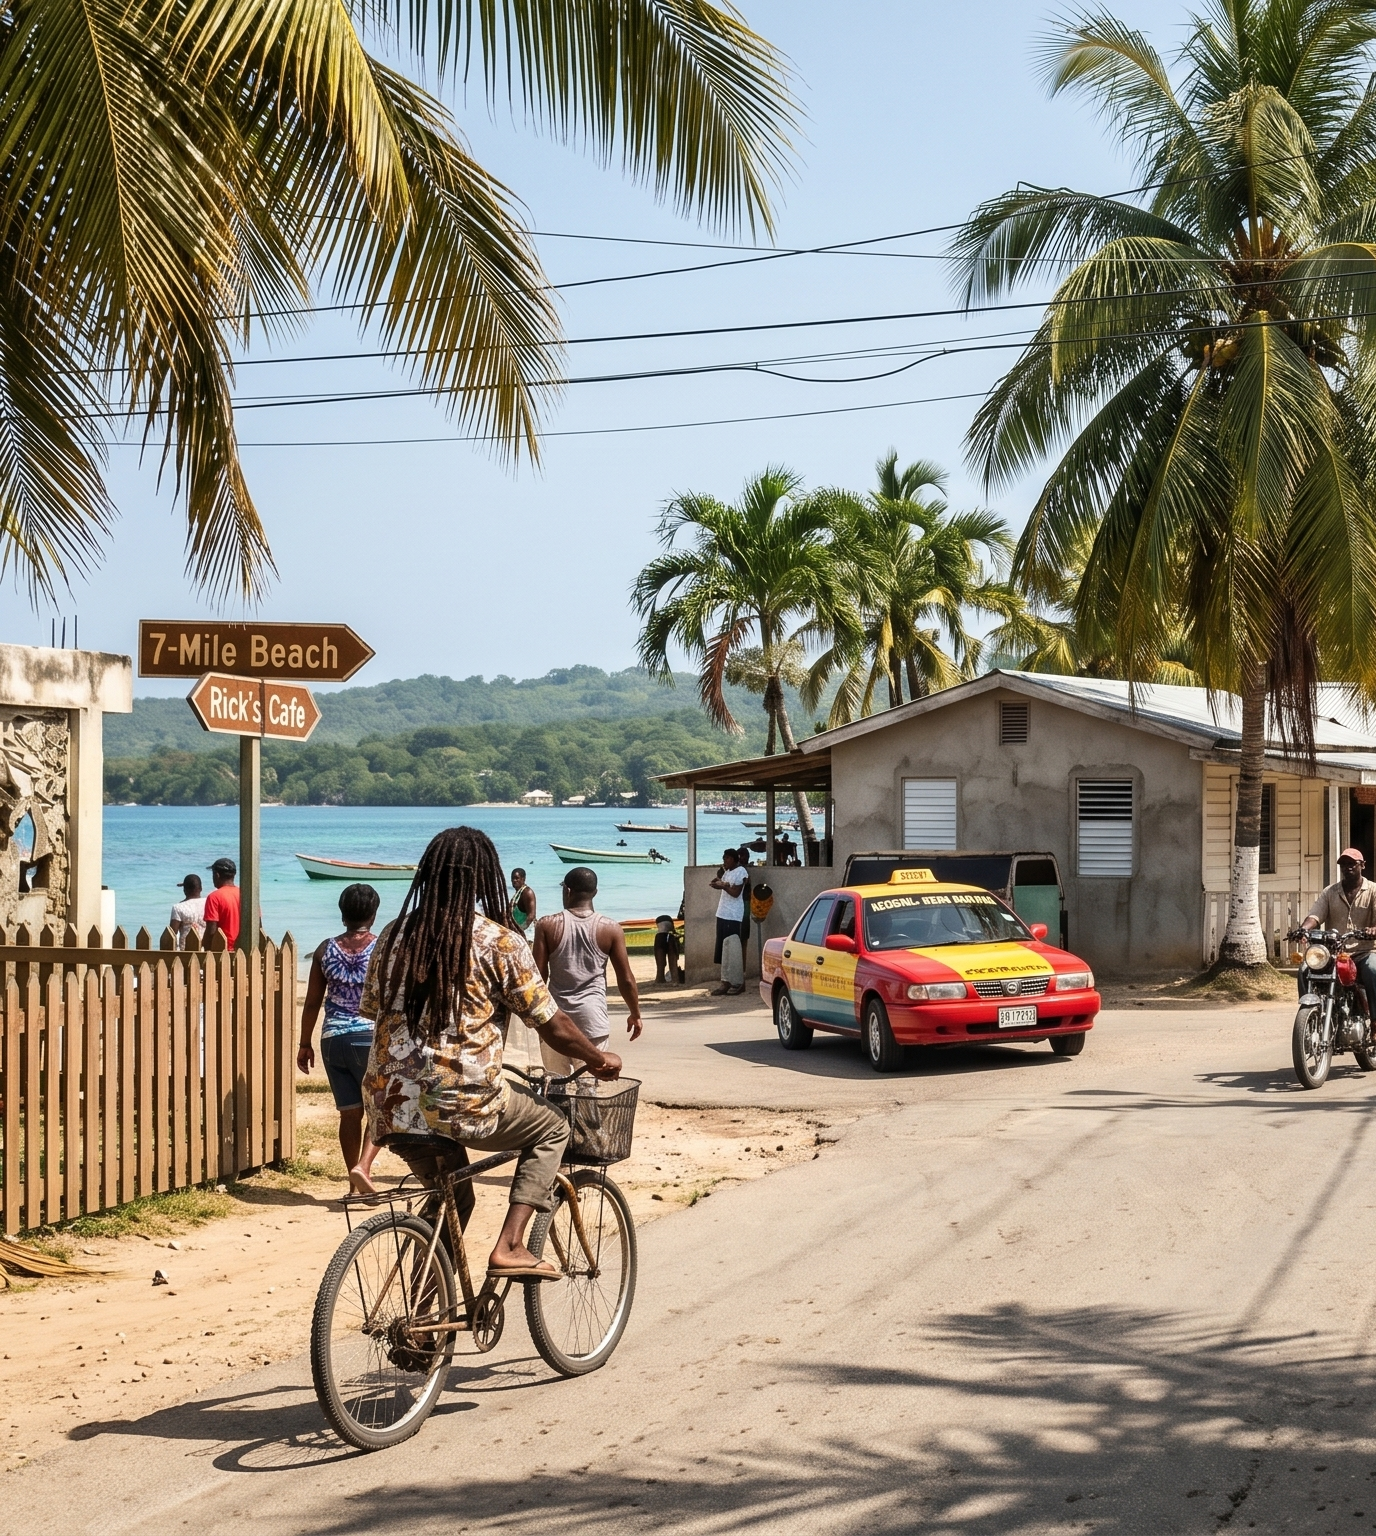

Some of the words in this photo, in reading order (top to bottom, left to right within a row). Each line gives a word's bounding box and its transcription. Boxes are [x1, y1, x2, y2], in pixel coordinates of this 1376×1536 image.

[150, 633, 237, 667] 7-Mile
[251, 635, 338, 669] Beach
[210, 685, 261, 724] Rick's
[269, 694, 306, 729] Cafe
